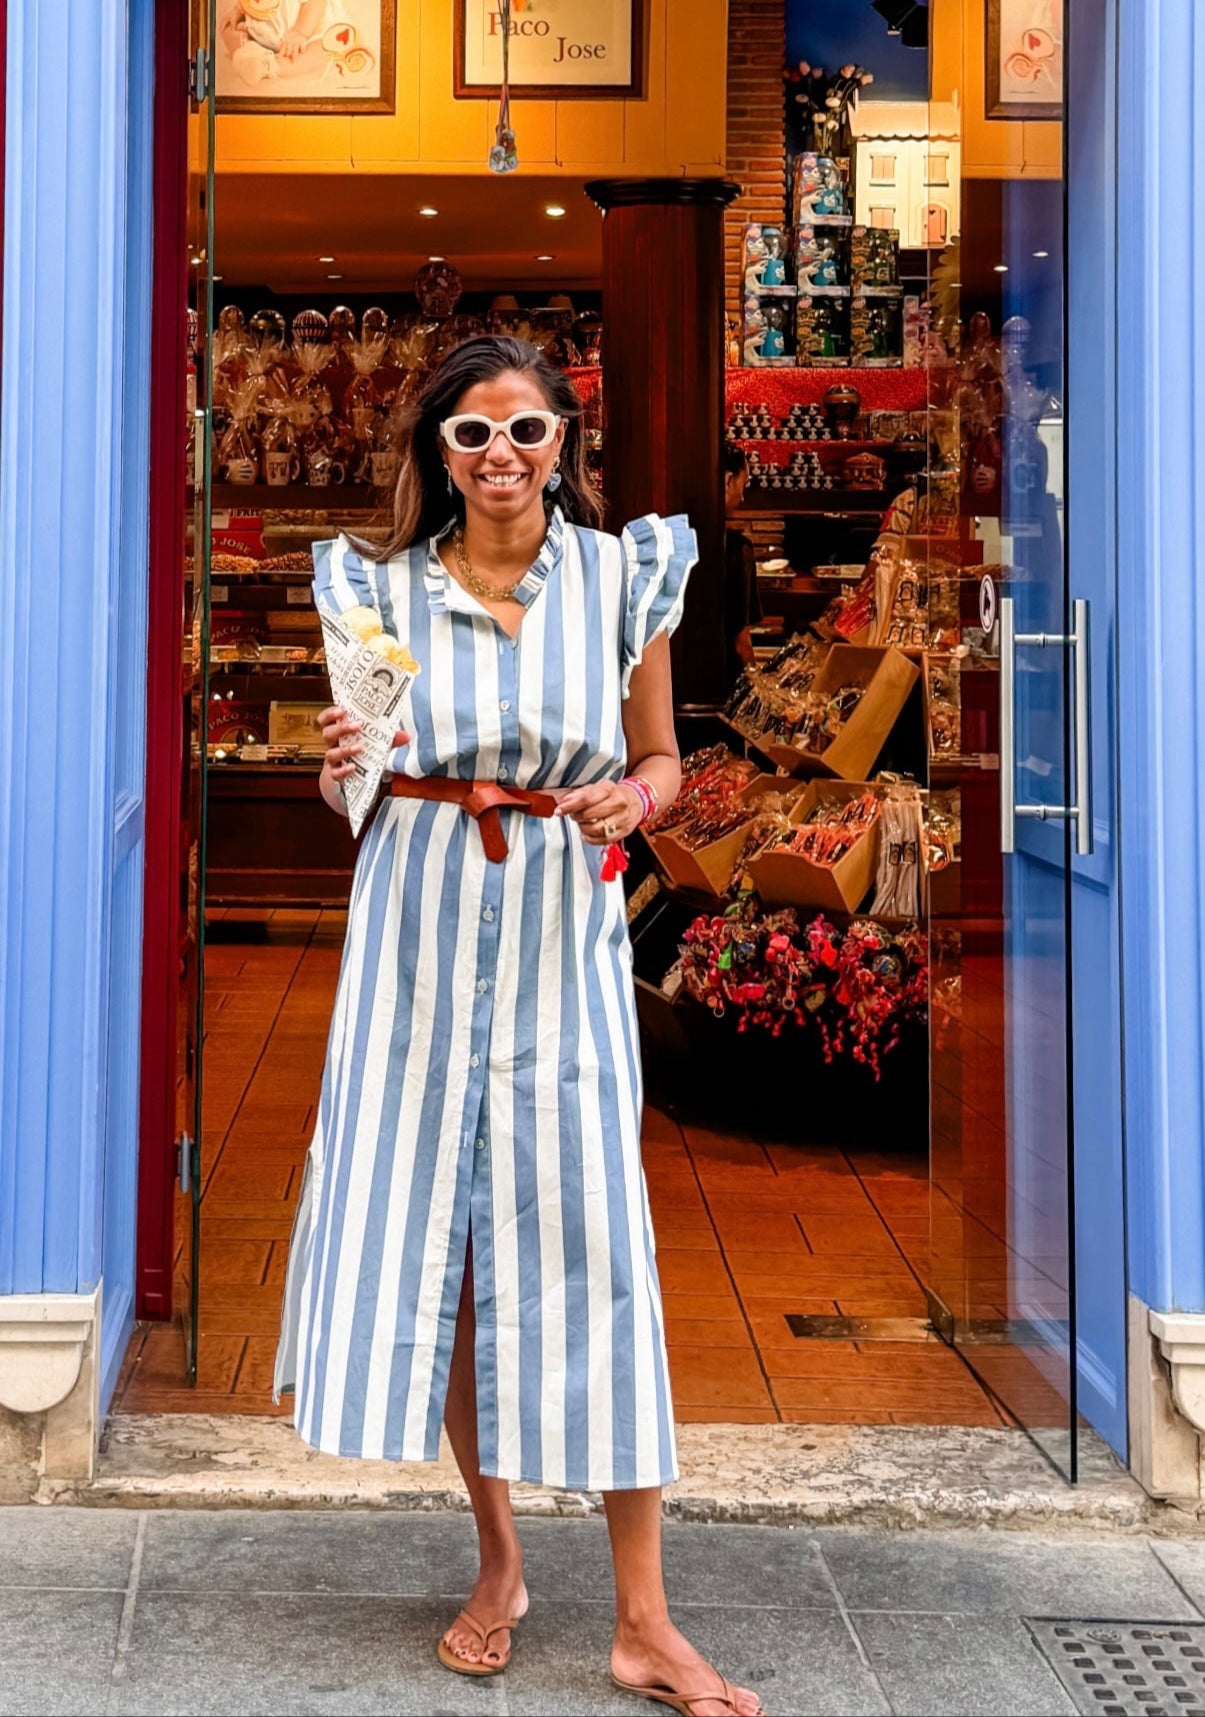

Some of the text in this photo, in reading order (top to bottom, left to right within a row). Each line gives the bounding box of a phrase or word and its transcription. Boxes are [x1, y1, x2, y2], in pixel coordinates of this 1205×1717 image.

[553, 37, 606, 62] Jose
[356, 694, 377, 712] JOSE
[361, 685, 384, 705] PACO
[208, 711, 241, 731] PACO
